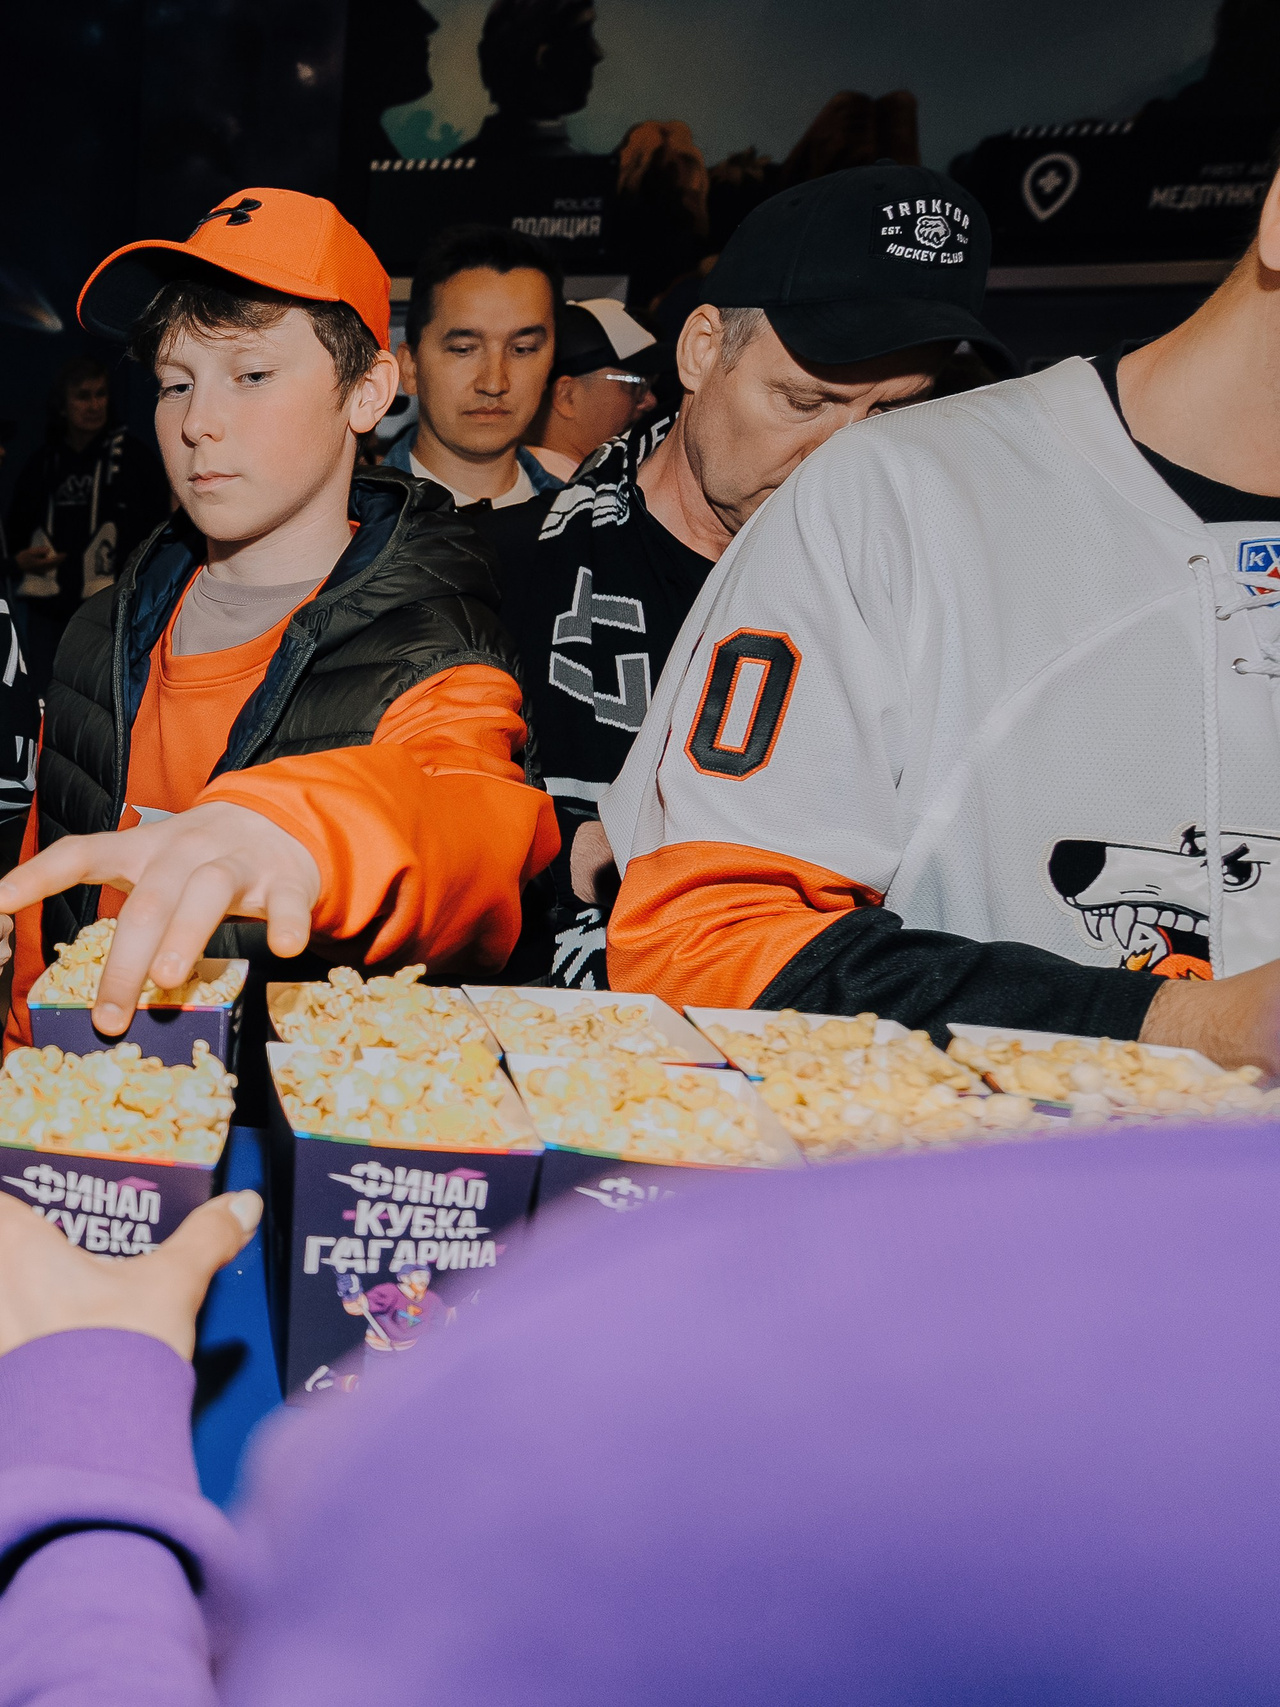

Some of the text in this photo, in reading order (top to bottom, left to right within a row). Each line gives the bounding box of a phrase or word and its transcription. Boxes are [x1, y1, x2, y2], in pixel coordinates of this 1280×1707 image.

[881, 226, 903, 235] EST.
[882, 199, 970, 229] TRAKTOR
[886, 242, 964, 264] HOCKEY CLUB
[1, 1163, 161, 1224] ФИНАЛ
[327, 1161, 489, 1210] ФИНАЛ
[353, 1199, 491, 1239] КУБКА
[303, 1235, 497, 1275] ГАГАРИНА
